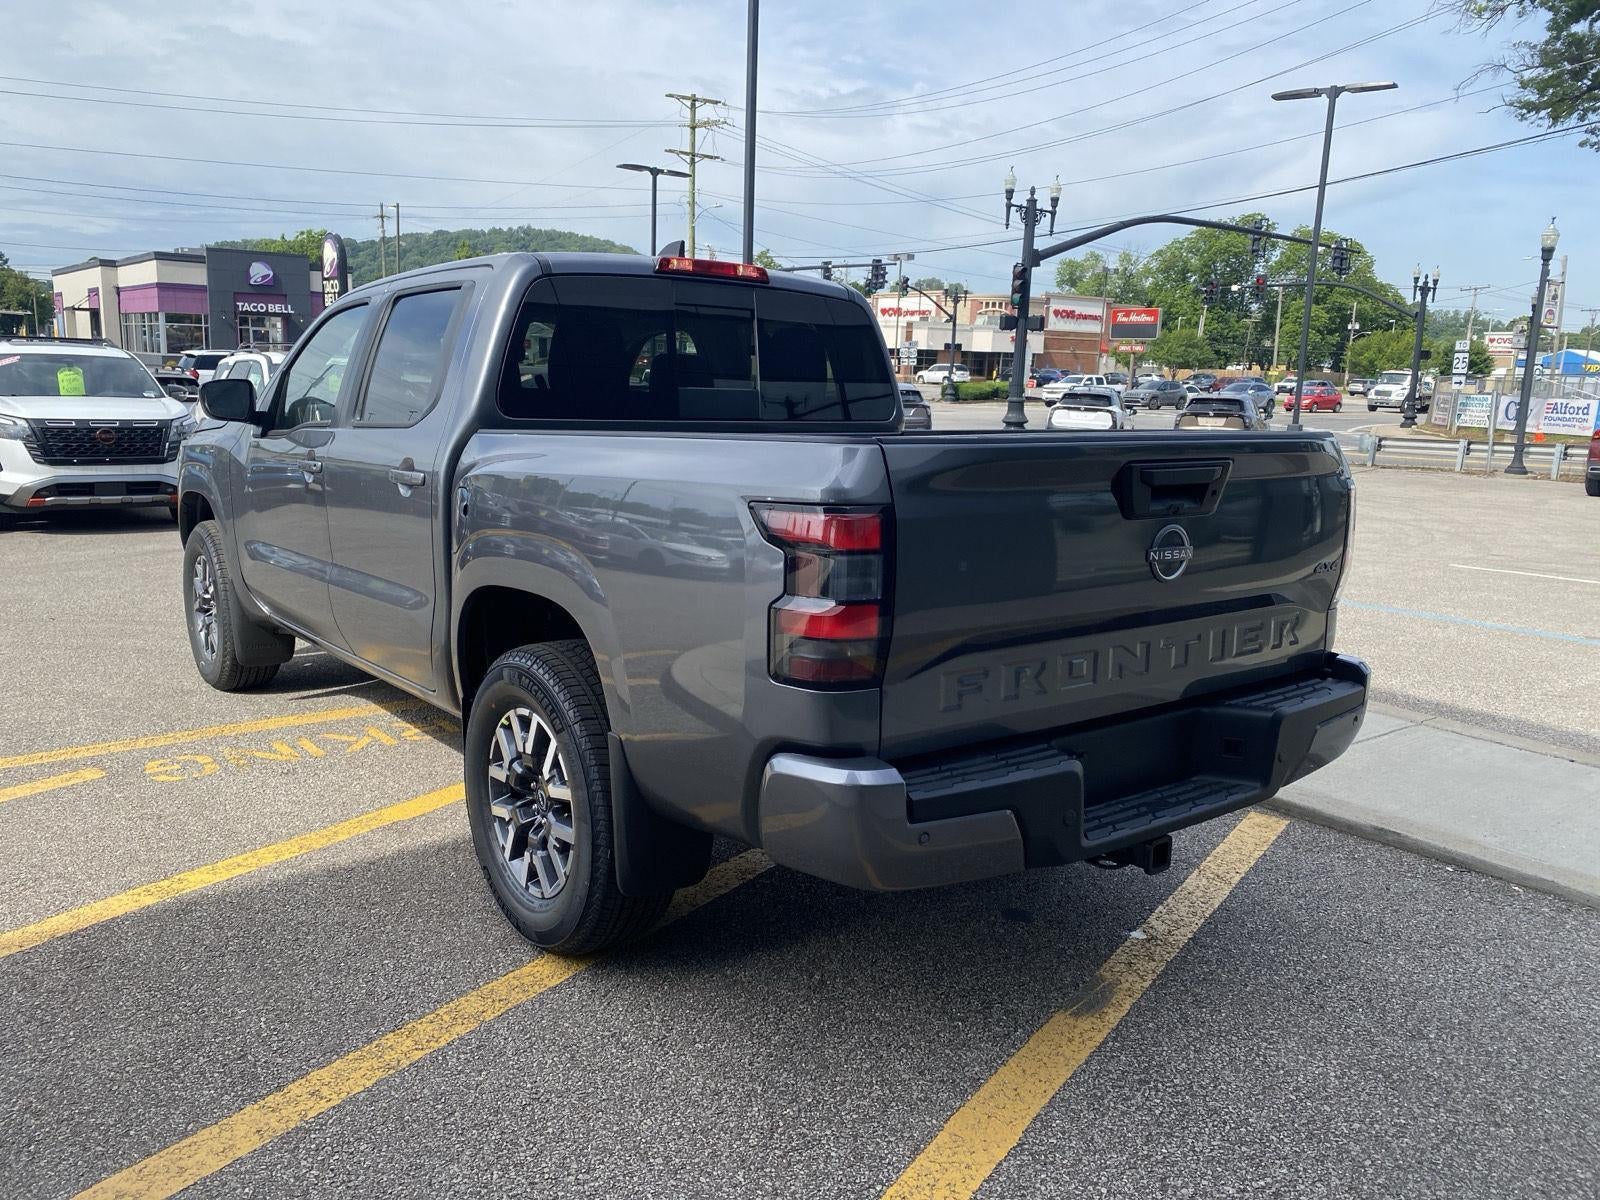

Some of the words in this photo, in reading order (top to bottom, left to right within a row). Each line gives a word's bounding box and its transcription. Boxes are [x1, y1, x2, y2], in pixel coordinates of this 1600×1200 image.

[323, 280, 339, 293] TACO
[236, 302, 266, 312] TACO
[268, 304, 295, 314] BELL
[887, 307, 902, 317] CVS
[903, 309, 932, 318] pharmacy
[1060, 309, 1076, 320] CVS
[1116, 312, 1128, 322] Tim
[1129, 312, 1155, 322] Hortons
[1496, 337, 1513, 345] CVS
[1453, 356, 1468, 370] 25
[1551, 401, 1591, 416] Alford
[1544, 415, 1588, 424] FOUNDATION
[1149, 549, 1193, 560] NISSAN
[939, 610, 1301, 713] FRONTIER
[520, 674, 564, 734] MICHELIN
